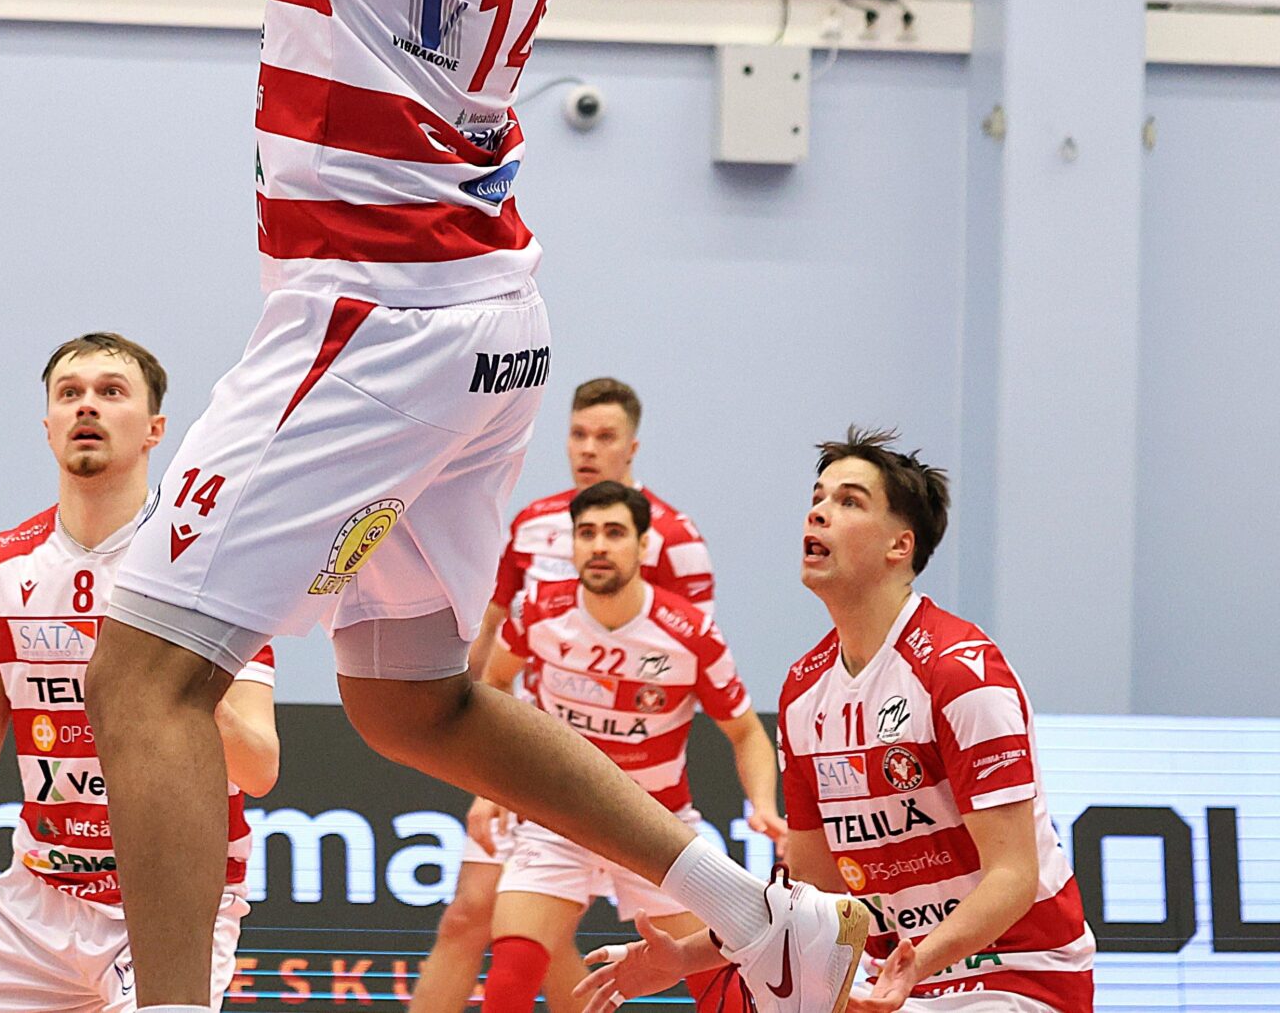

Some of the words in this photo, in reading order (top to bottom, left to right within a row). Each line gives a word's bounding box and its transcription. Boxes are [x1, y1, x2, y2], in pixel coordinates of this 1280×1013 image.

[392, 35, 459, 72] VIBRAKONE
[468, 345, 551, 395] Namm
[174, 467, 226, 518] 14
[72, 570, 95, 614] 8
[20, 625, 84, 650] SATA
[587, 645, 628, 678] 22
[842, 701, 866, 747] 11
[822, 797, 937, 844] TELILÄ
[228, 958, 426, 1005] ESKU
